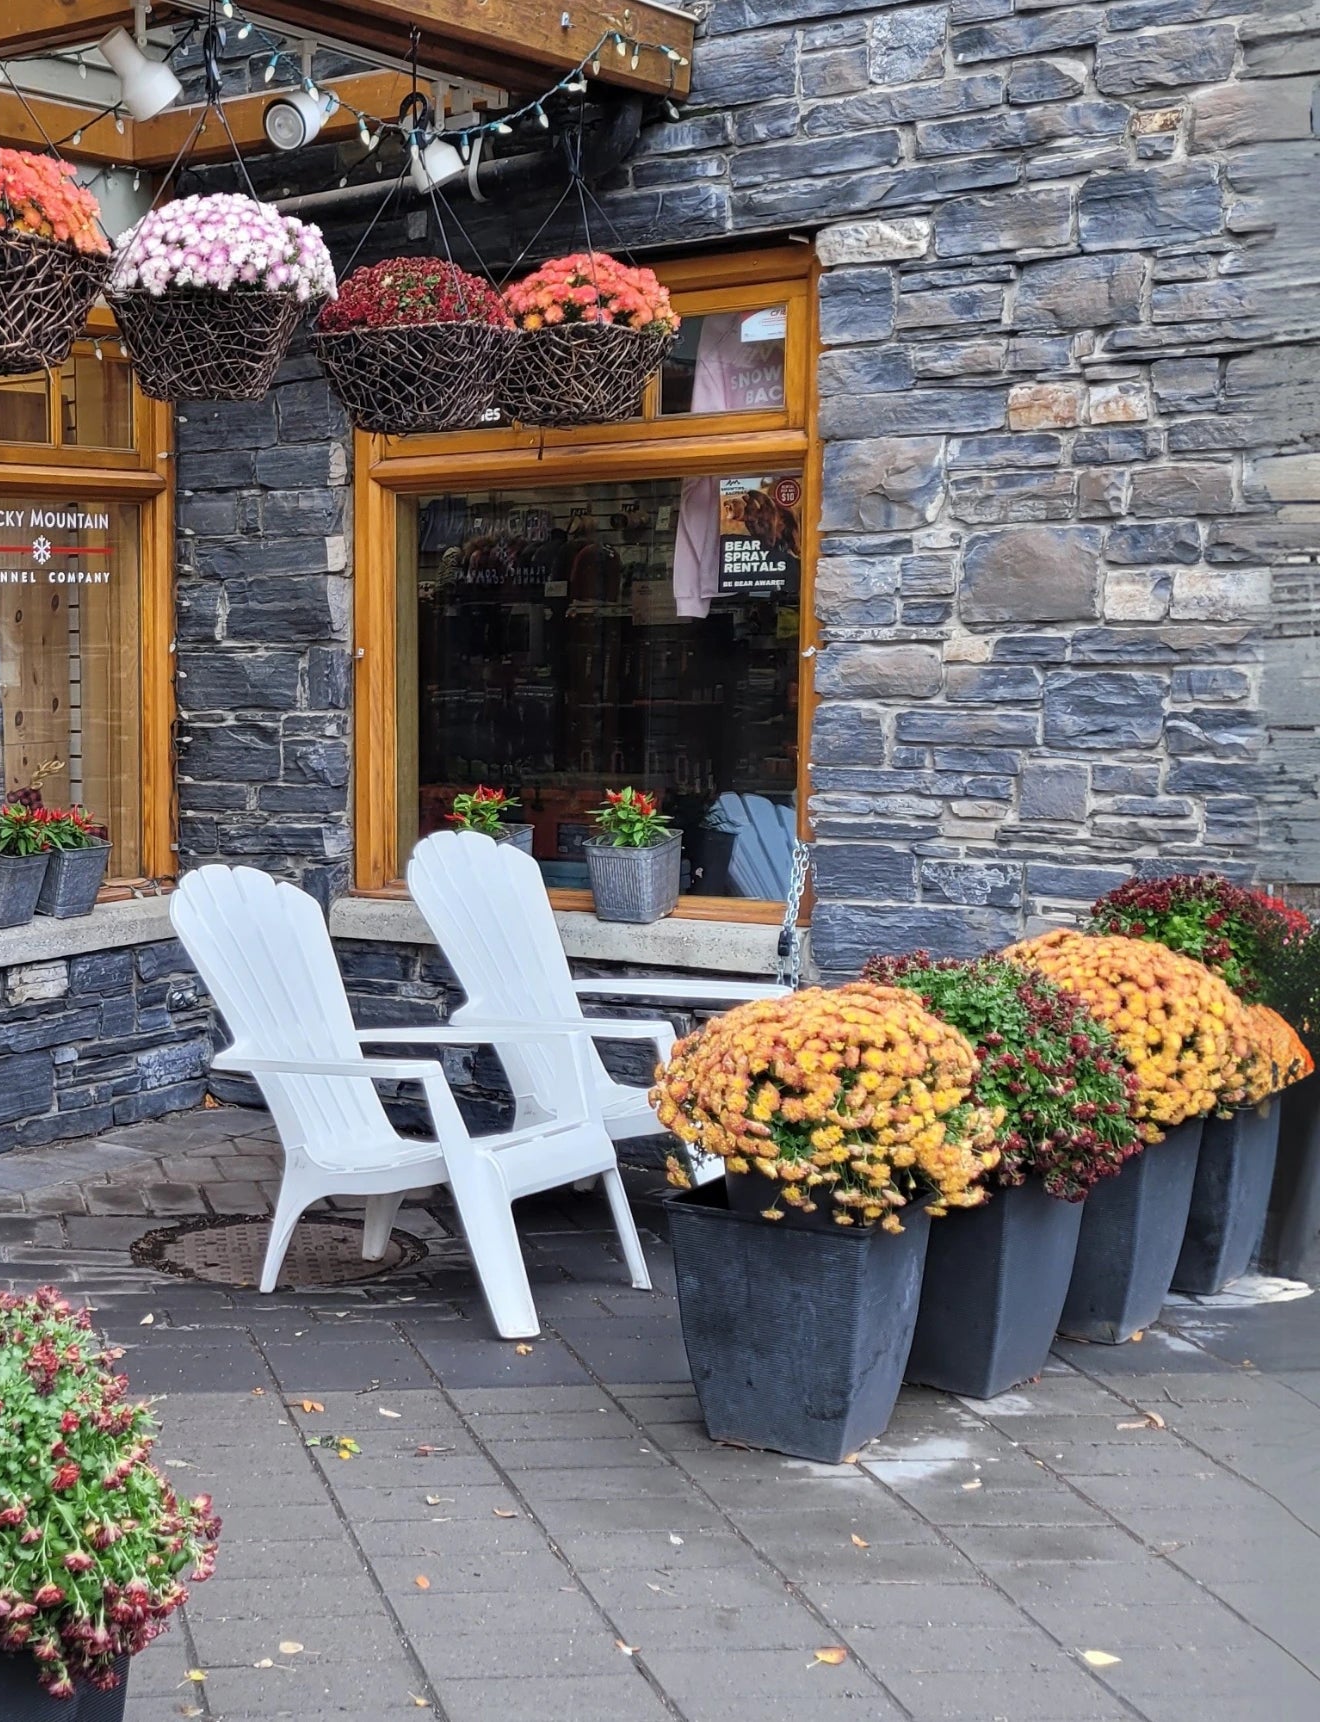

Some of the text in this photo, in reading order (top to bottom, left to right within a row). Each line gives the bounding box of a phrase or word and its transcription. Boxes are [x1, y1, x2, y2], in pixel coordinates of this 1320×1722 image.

[731, 366, 782, 390] SNOW
[745, 385, 784, 405] BAC
[781, 492, 795, 502] $10
[30, 508, 110, 530] MOUNTAIN
[724, 540, 761, 552] BEAR
[724, 550, 770, 563] SPRAY
[723, 560, 787, 574] RENTALS
[48, 571, 111, 584] COMPANY
